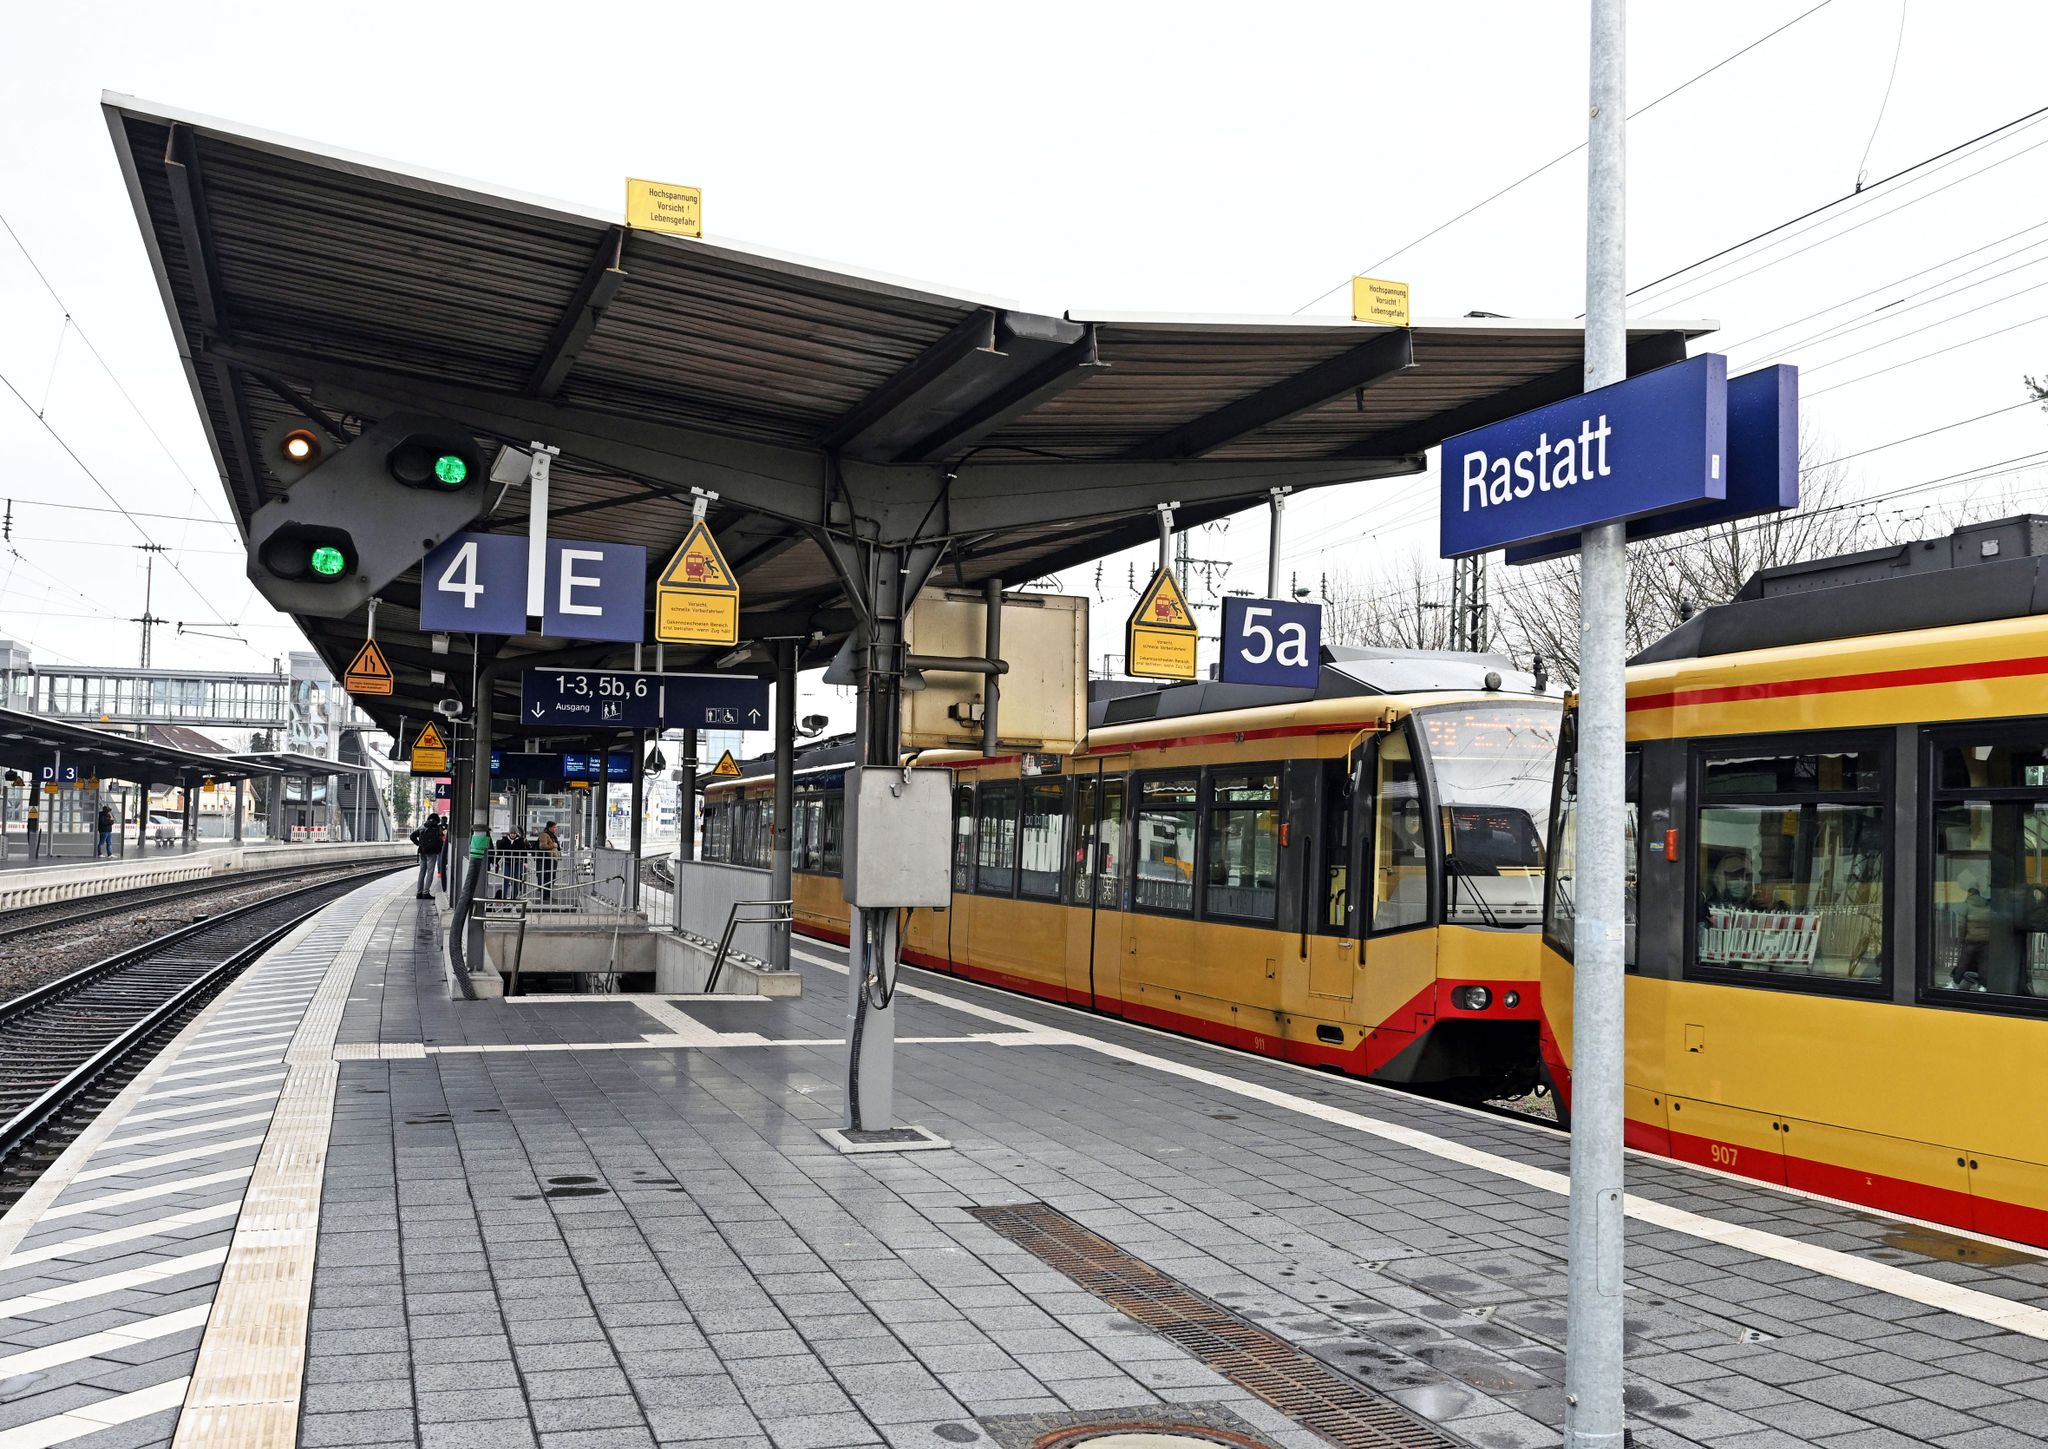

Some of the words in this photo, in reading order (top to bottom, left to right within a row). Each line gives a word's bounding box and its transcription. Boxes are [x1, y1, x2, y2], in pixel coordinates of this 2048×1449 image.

[649, 188, 698, 205] Hochspannung
[657, 201, 685, 213] Vorsicht
[650, 212, 696, 226] Lebensgefahr
[1369, 285, 1406, 299] Hochspannung
[1376, 296, 1397, 306] Vorsicht
[1371, 306, 1405, 317] Lebensgefahr
[1463, 414, 1611, 512] Rastatt
[438, 541, 484, 608] 4
[559, 548, 604, 616] E
[1240, 606, 1309, 667] 5a
[556, 675, 593, 698] 1-3,
[599, 677, 630, 700] 5b,
[635, 678, 648, 697] 6
[555, 702, 590, 713] Ausgang
[43, 767, 54, 779] D
[66, 767, 75, 780] 3
[437, 784, 446, 796] 4
[1254, 1036, 1265, 1050] 911
[1711, 1144, 1738, 1166] 907
